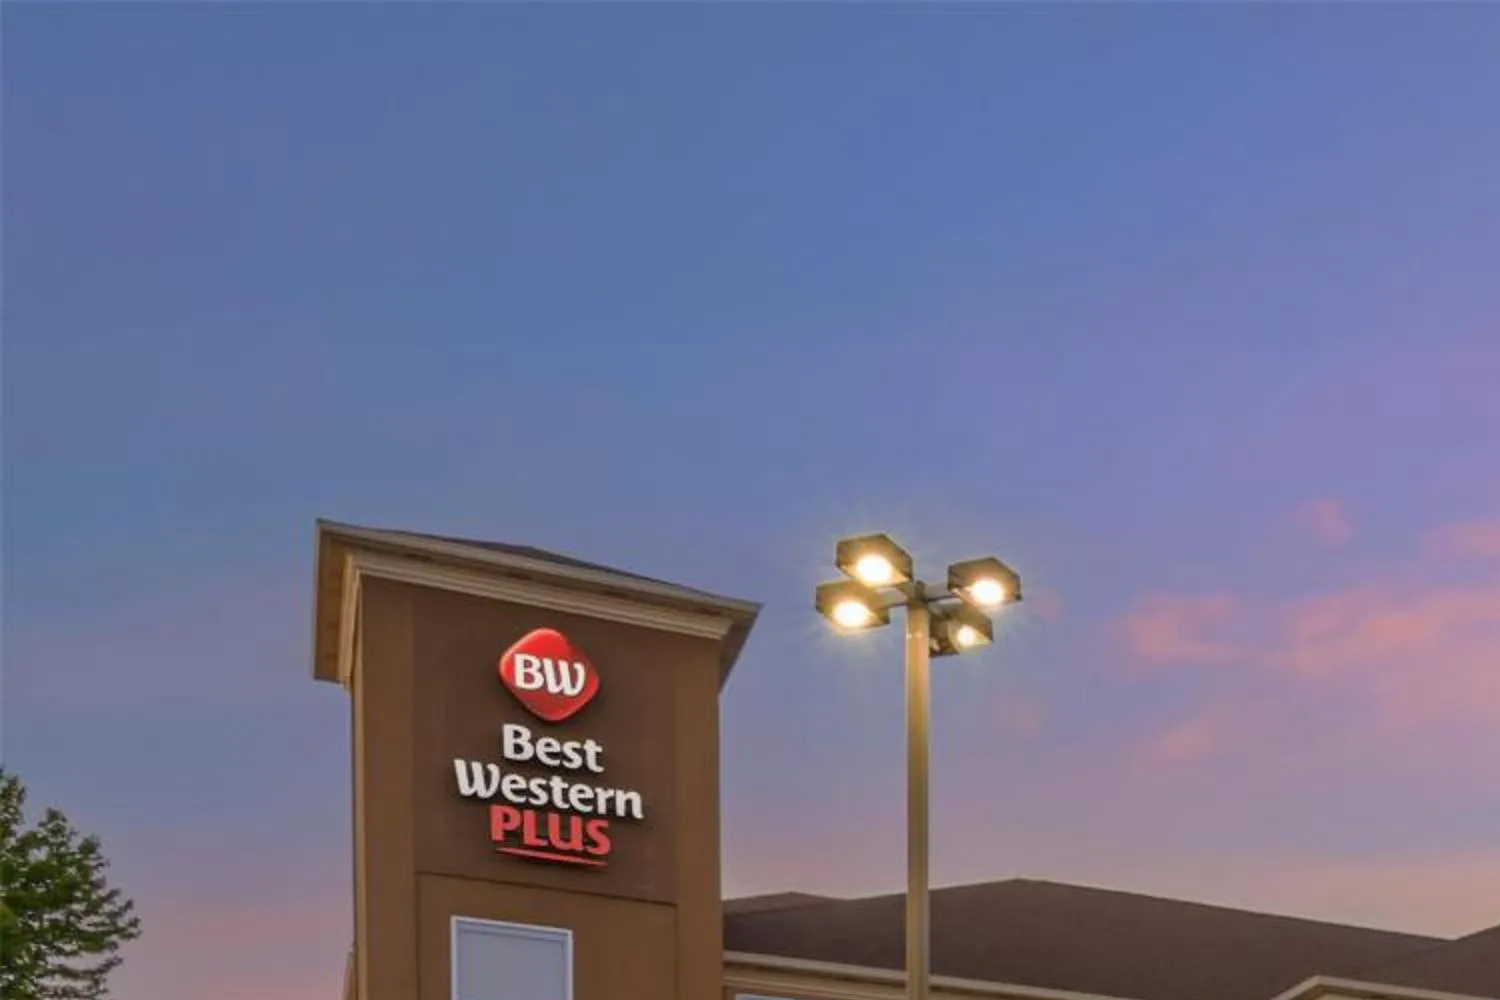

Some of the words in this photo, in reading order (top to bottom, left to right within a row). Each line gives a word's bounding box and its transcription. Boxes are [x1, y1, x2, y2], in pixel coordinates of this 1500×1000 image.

[513, 653, 586, 696] BW
[503, 723, 604, 773] Best
[454, 758, 644, 819] Western
[490, 804, 611, 855] PLUS
